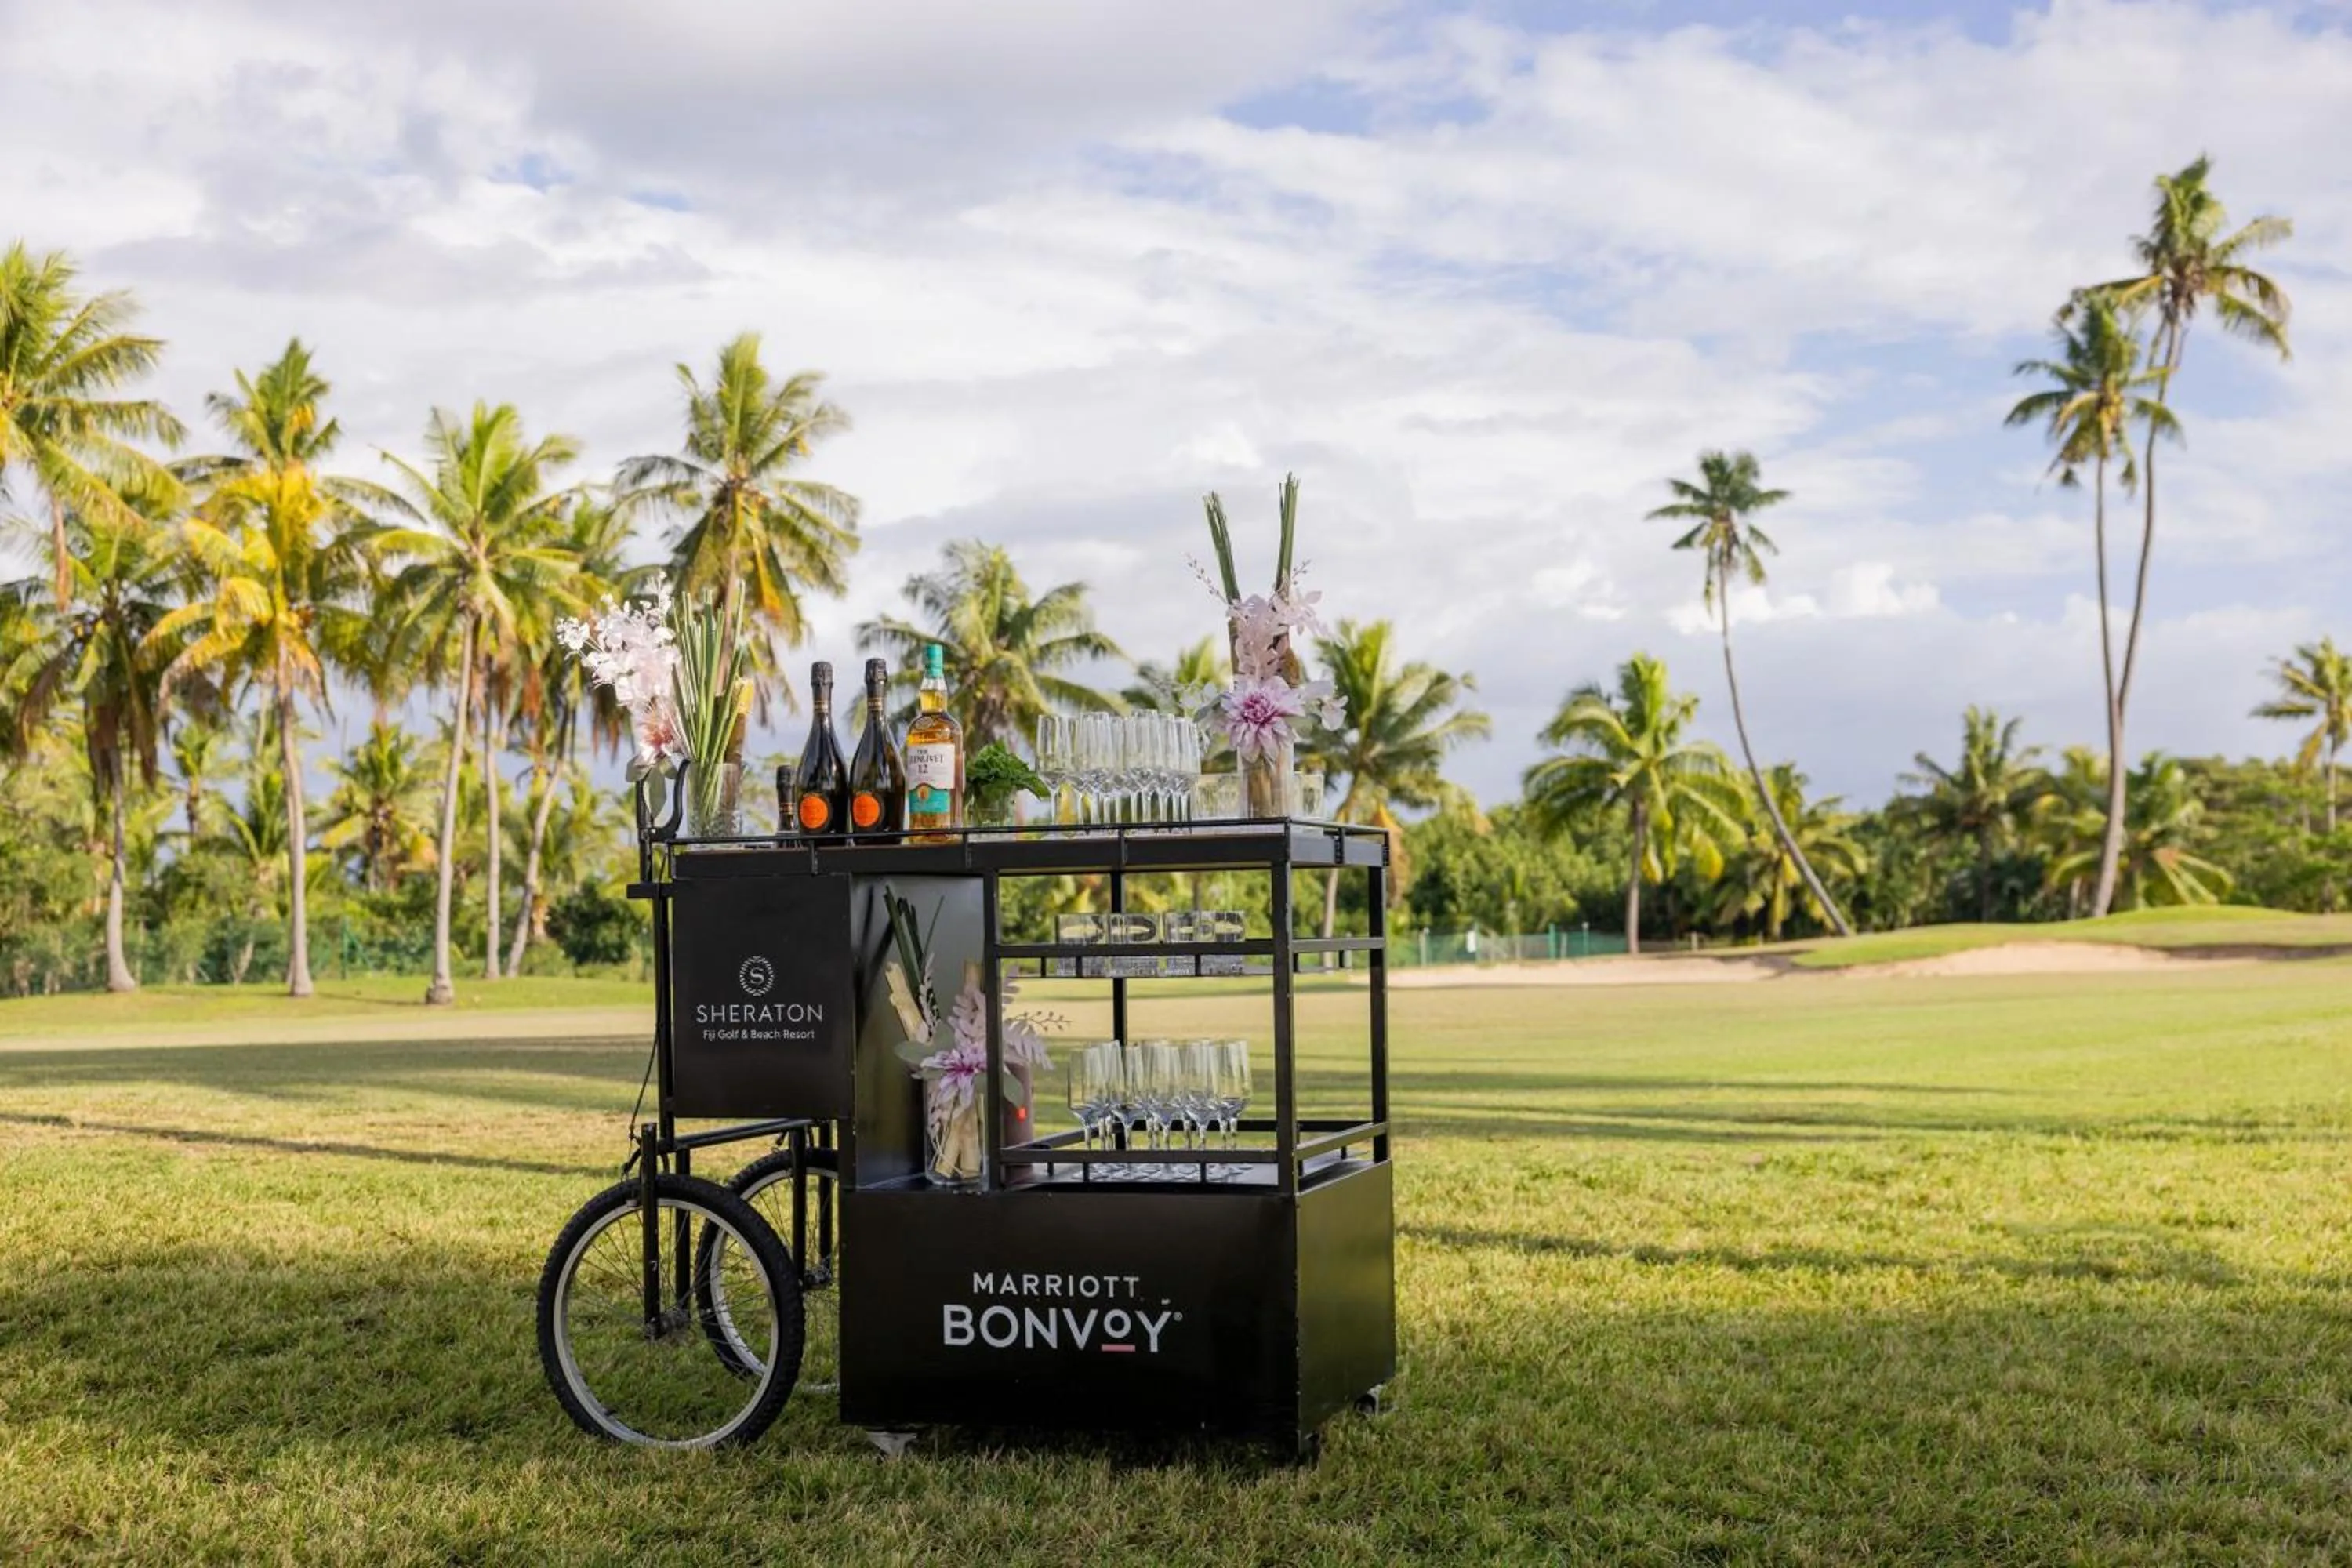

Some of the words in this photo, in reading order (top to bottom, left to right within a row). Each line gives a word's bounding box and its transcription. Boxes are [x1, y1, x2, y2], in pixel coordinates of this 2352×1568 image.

[918, 764, 928, 774] 12
[696, 1004, 823, 1023] SHERATON
[703, 1029, 715, 1042] Fiji
[717, 1029, 739, 1040] Golf
[741, 1029, 748, 1040] &
[750, 1029, 780, 1040] Beach
[783, 1029, 815, 1040] Resort
[973, 1272, 1139, 1298] MARRIOTT
